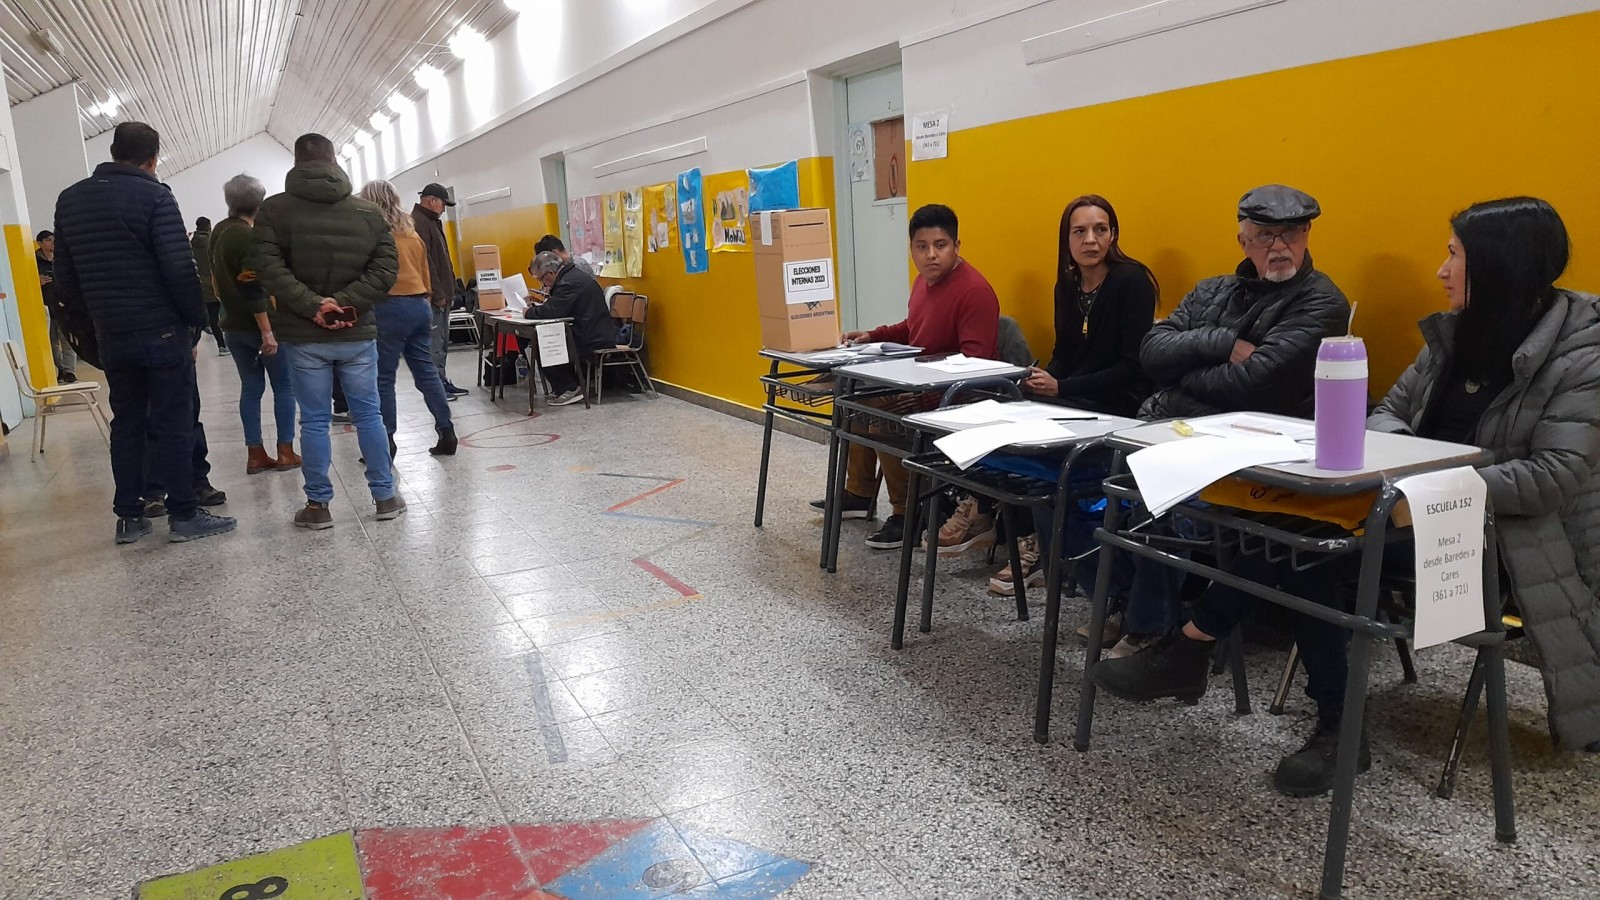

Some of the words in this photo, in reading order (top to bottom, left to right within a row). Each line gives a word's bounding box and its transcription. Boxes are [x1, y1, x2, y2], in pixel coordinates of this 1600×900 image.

[922, 120, 936, 128] MESA
[936, 119, 940, 127] 2
[793, 265, 821, 276] ELECCIONES
[791, 276, 814, 286] INTERNAS
[1426, 500, 1458, 515] ESCUELA
[1459, 497, 1472, 509] 152
[1438, 535, 1456, 548] Mesa
[1457, 533, 1462, 544] 2
[1423, 556, 1443, 569] desde
[1444, 550, 1470, 564] Baredes
[1470, 549, 1475, 557] a
[1441, 570, 1459, 582] Cares
[1432, 588, 1448, 604] (361
[1449, 590, 1454, 598] a
[1454, 583, 1469, 596] 721)
